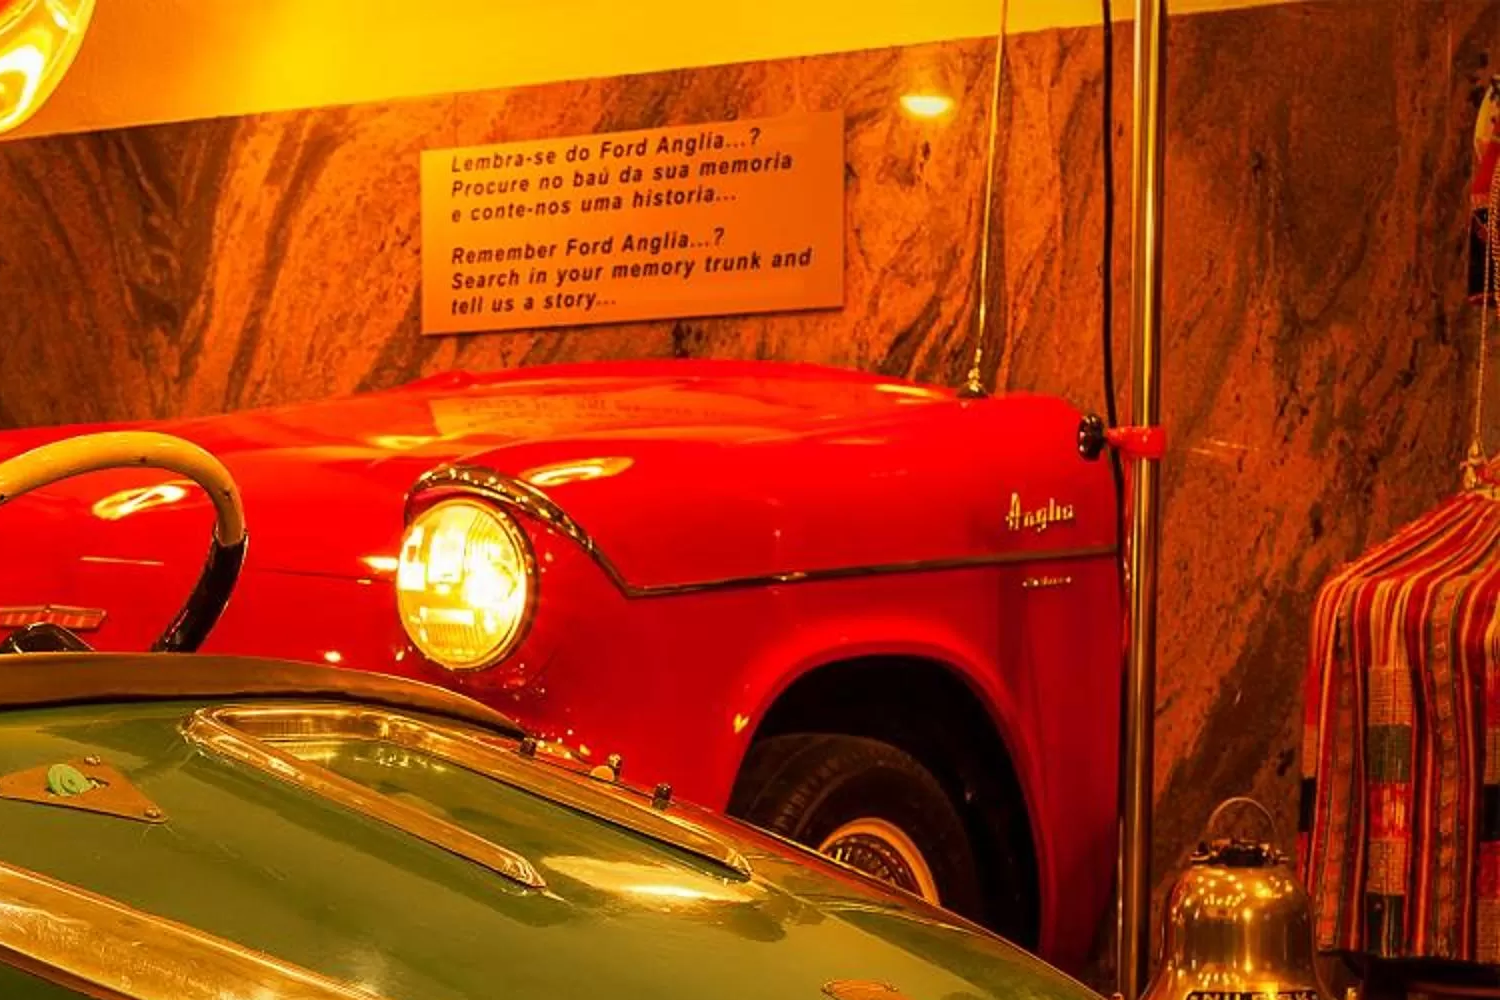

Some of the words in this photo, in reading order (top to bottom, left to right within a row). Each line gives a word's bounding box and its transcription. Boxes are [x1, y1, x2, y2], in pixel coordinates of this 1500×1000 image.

[451, 151, 557, 173] Lembra-se
[565, 143, 591, 163] do
[600, 136, 648, 159] Ford
[451, 178, 530, 198] Procure
[539, 174, 564, 190] no
[619, 165, 643, 183] da
[652, 163, 690, 181] sua
[700, 151, 793, 177] memoria
[451, 209, 461, 223] e
[470, 199, 571, 222] conte-nos
[581, 195, 623, 213] uma
[632, 185, 738, 208] historia...
[451, 243, 557, 265] Remember
[566, 235, 614, 256] Ford
[451, 268, 520, 290] Search
[528, 266, 548, 285] in
[556, 265, 604, 288] your
[612, 259, 696, 280] memory
[705, 251, 762, 273] trunk
[772, 246, 813, 268] and
[451, 296, 484, 316] tell
[491, 297, 515, 313] us
[523, 296, 534, 311] a
[543, 291, 617, 312] story...
